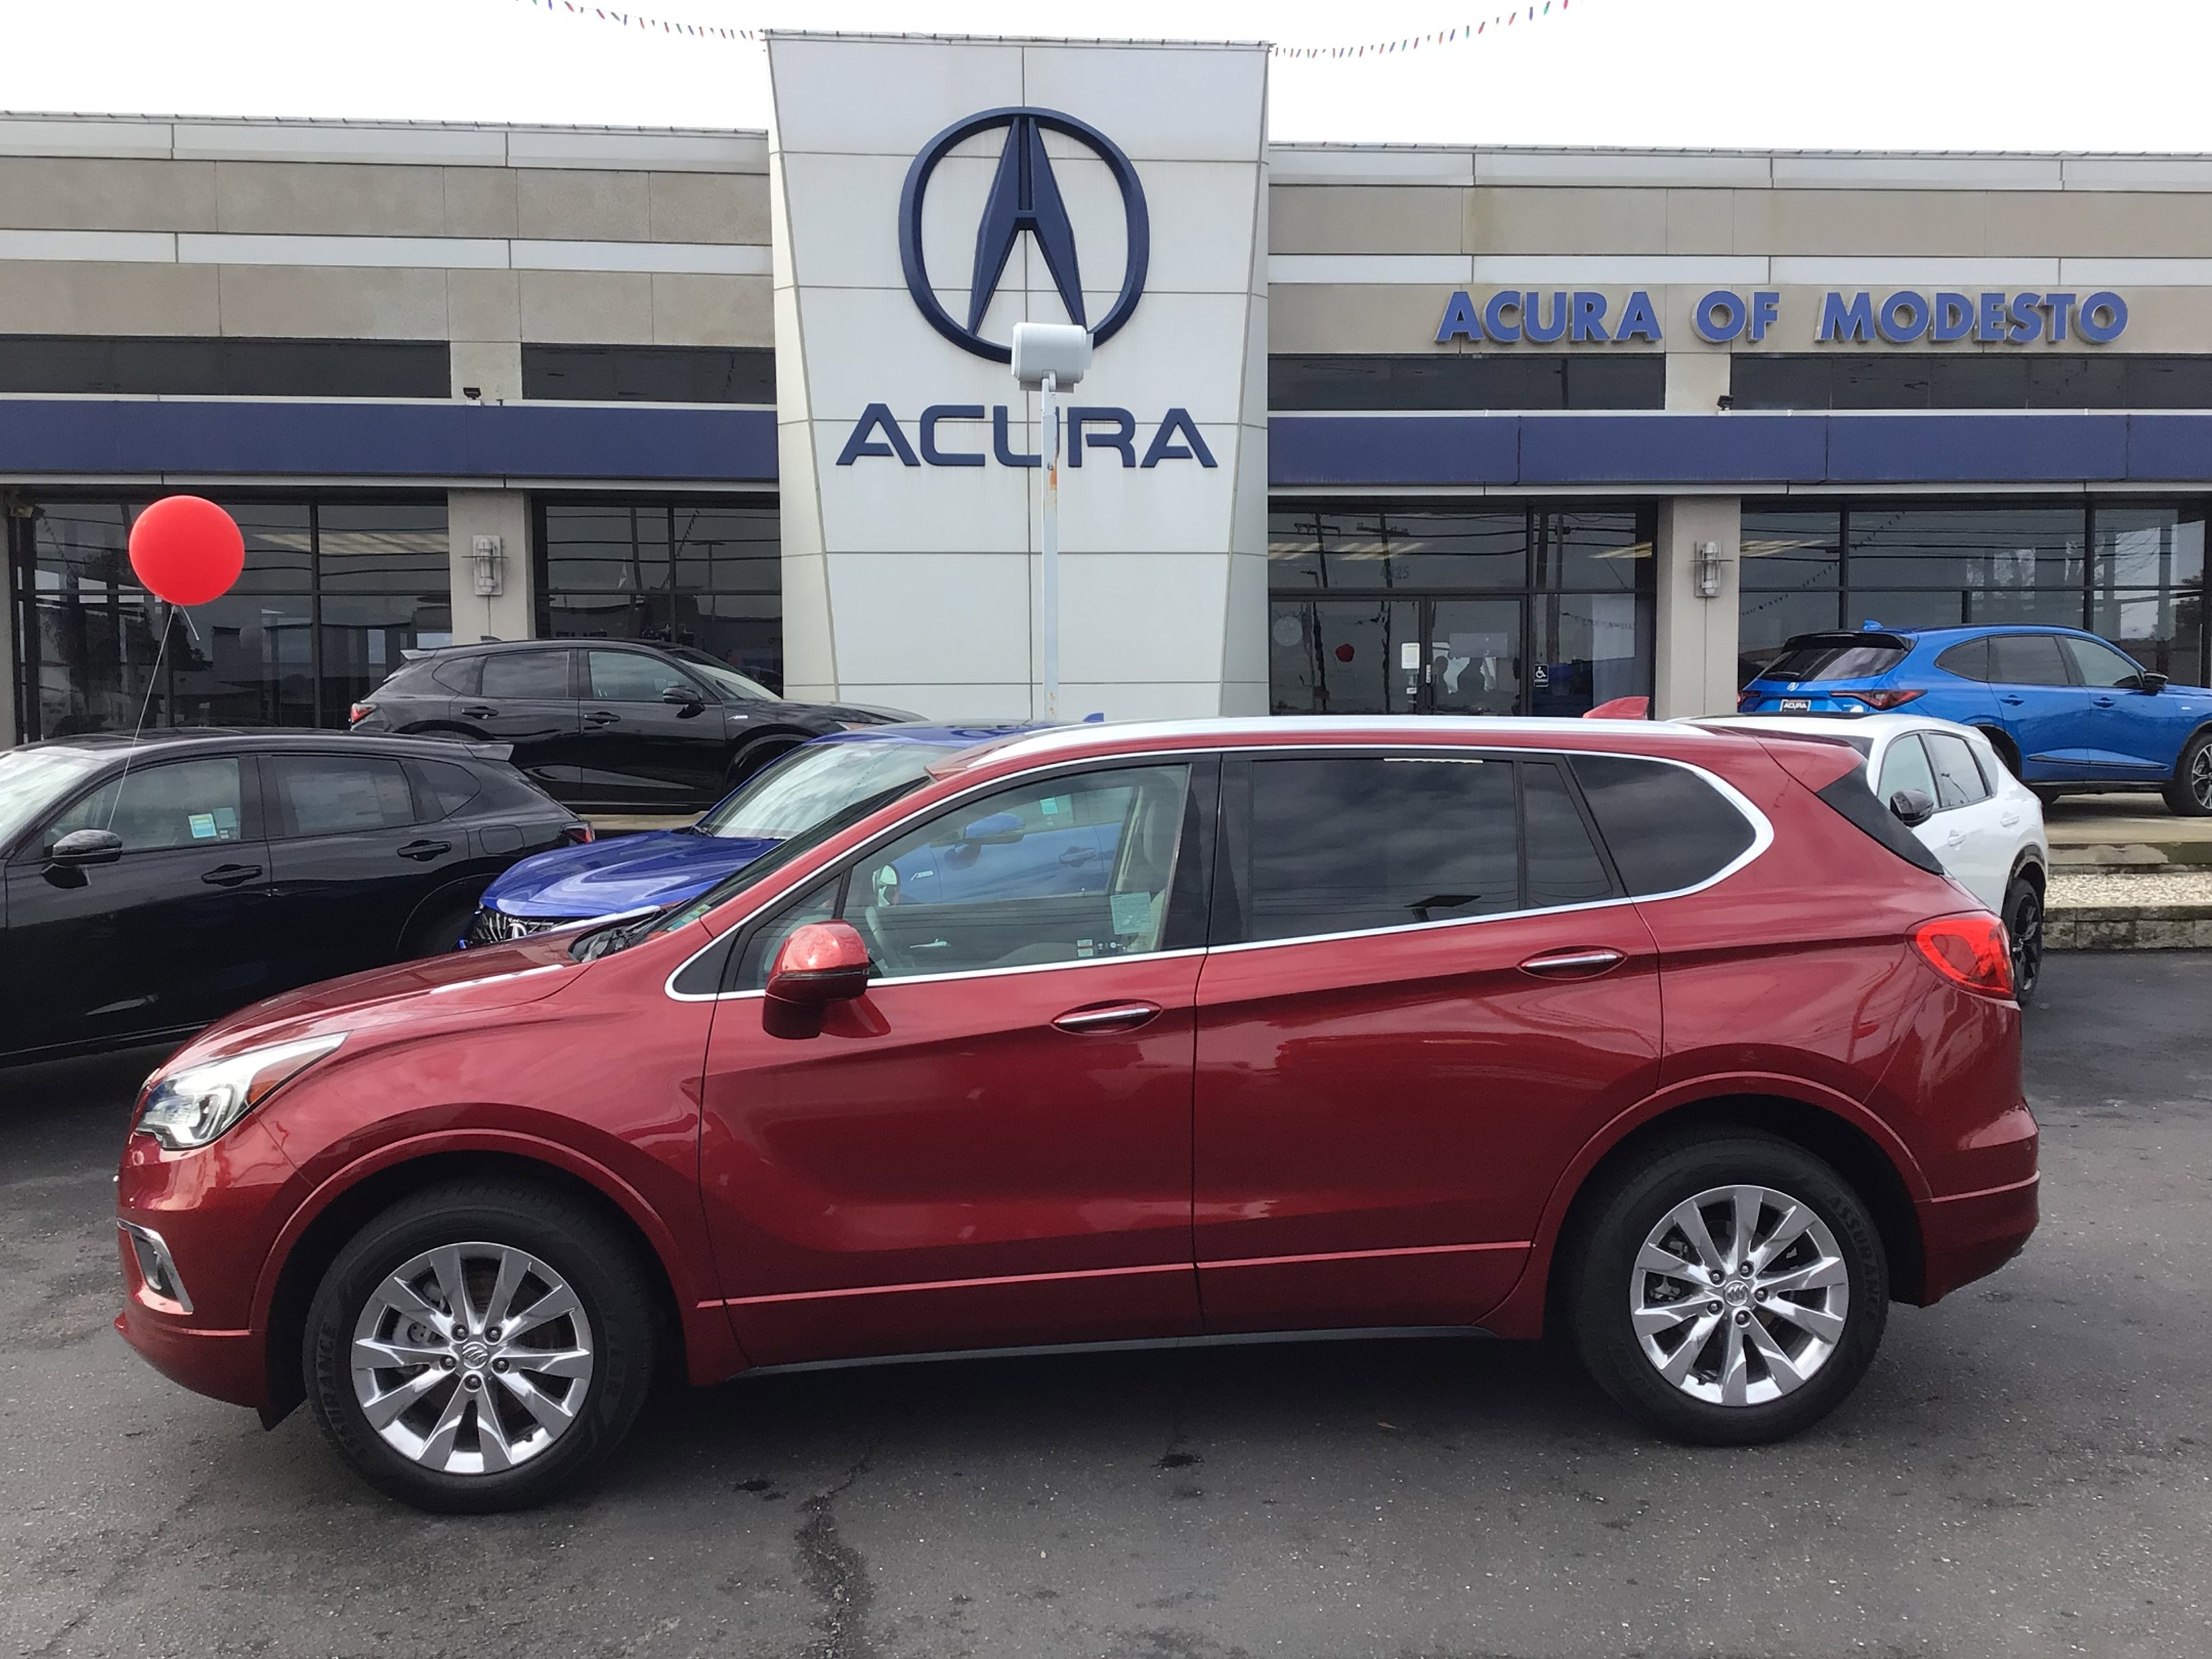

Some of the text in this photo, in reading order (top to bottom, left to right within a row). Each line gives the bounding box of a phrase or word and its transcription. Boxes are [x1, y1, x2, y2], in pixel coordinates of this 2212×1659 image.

[1435, 290, 2129, 343] ACURA OF MODESTO
[836, 403, 1218, 468] ACURA
